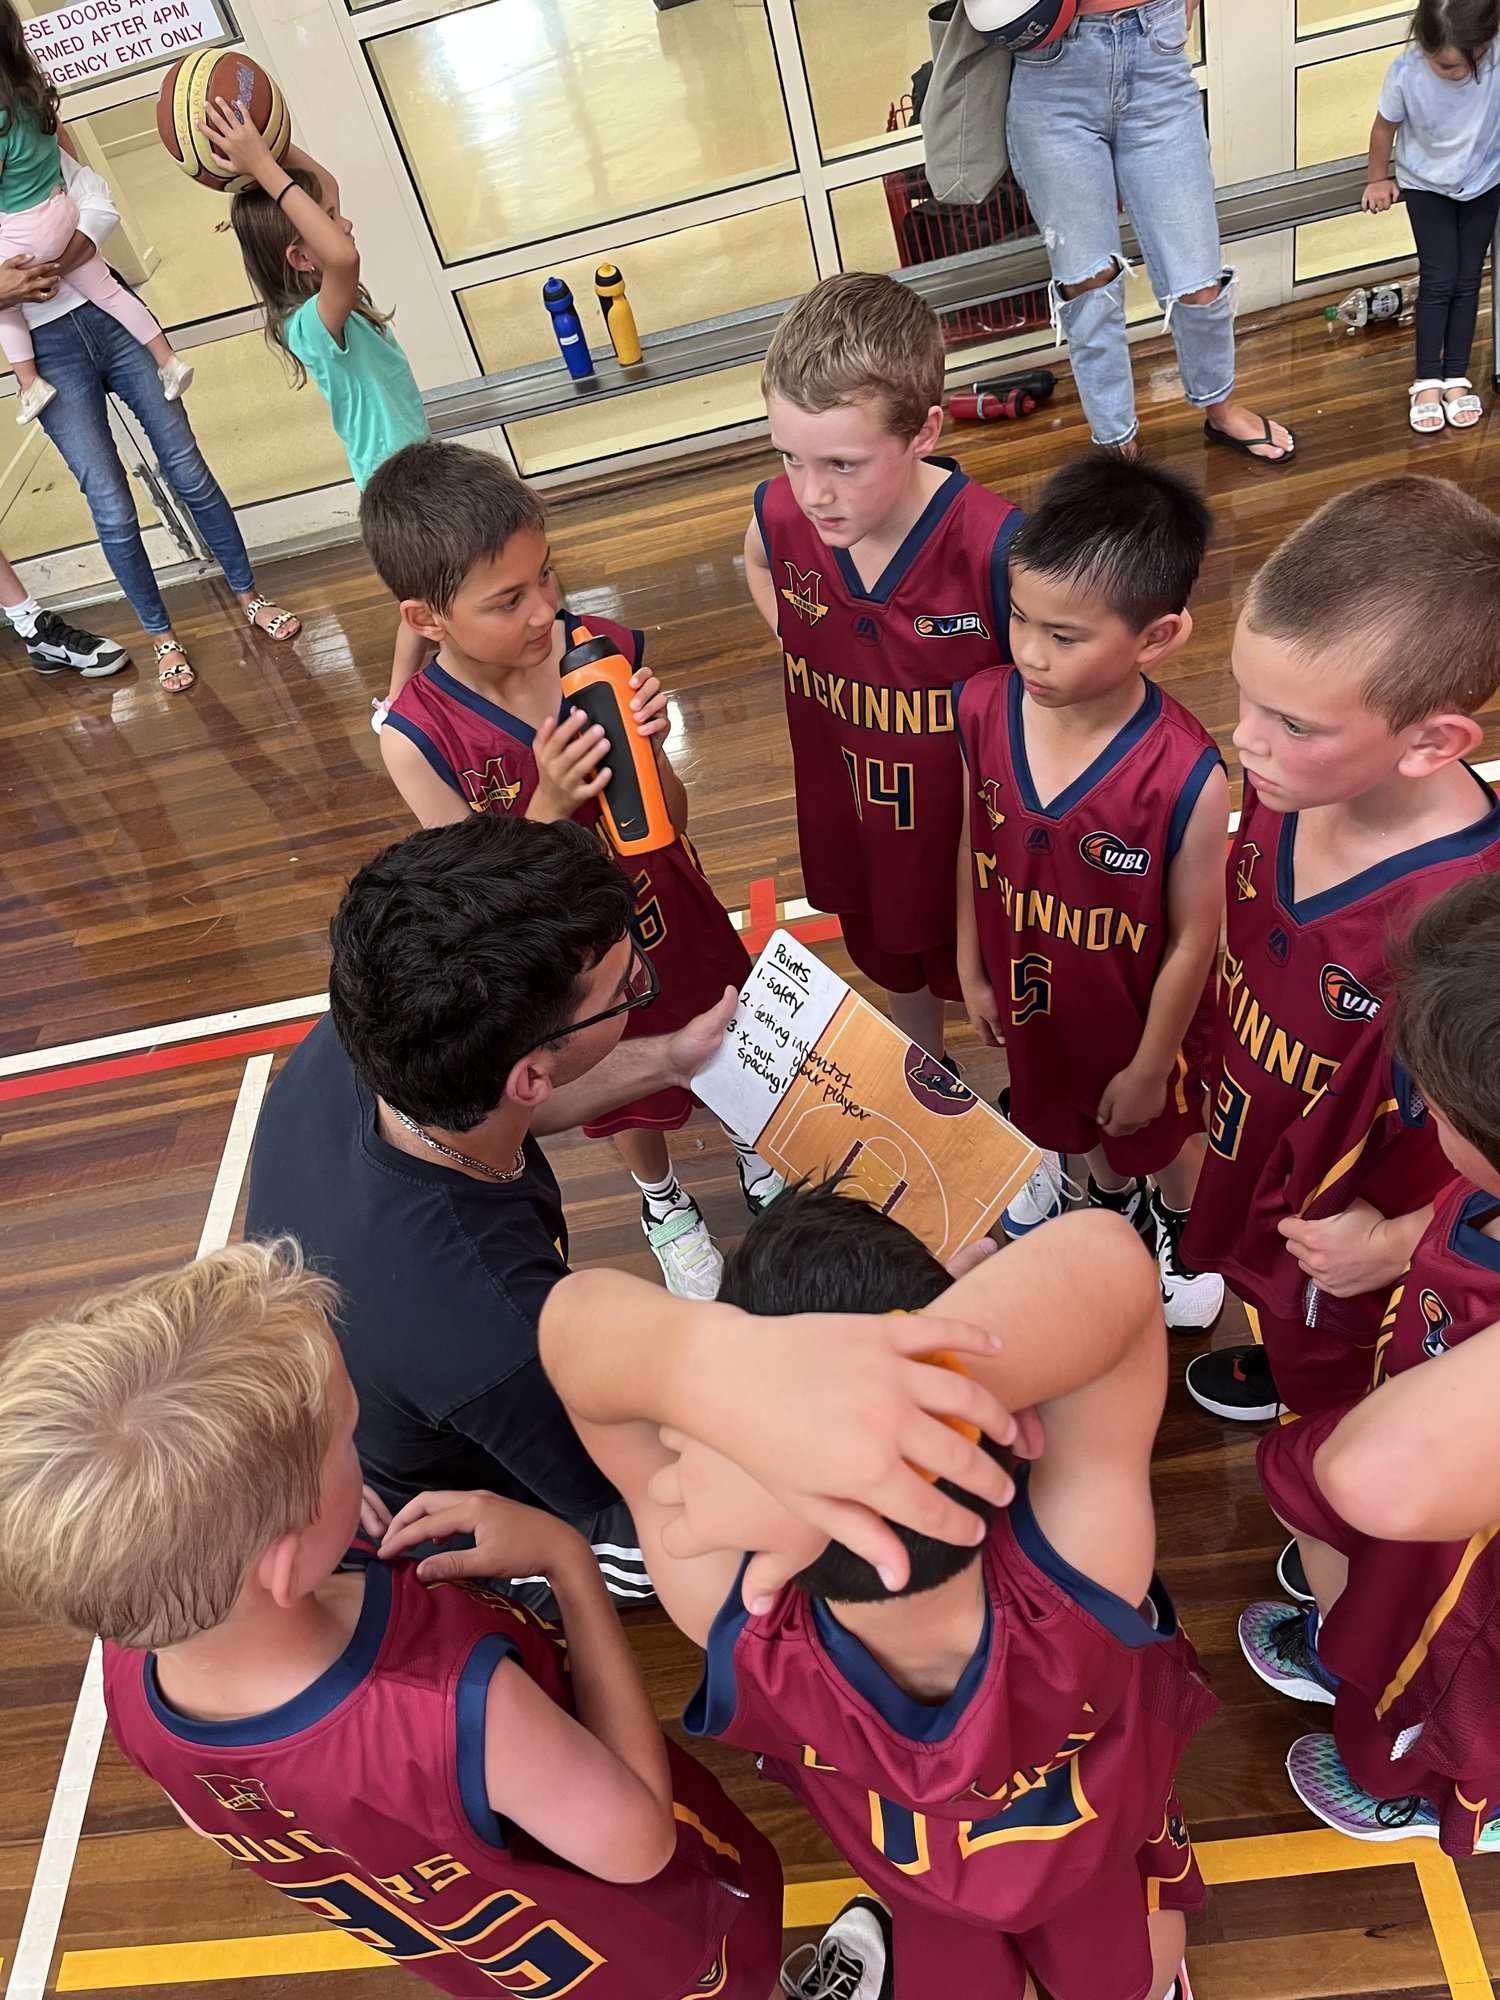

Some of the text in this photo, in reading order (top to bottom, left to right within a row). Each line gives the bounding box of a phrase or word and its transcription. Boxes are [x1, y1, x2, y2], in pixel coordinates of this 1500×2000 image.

[23, 0, 122, 42] ESE DOORS
[33, 1, 190, 63] RMED AFTER 4PM
[42, 22, 204, 88] RGENCY EXIT ONLY
[785, 652, 955, 735] McKINNO
[841, 745, 915, 831] 14
[1103, 849, 1145, 871] VJBL
[974, 851, 1149, 953] MINNON
[774, 943, 811, 983] Points
[1011, 953, 1052, 1025] 5
[1342, 991, 1381, 1019] VJ
[822, 1084, 871, 1121] player
